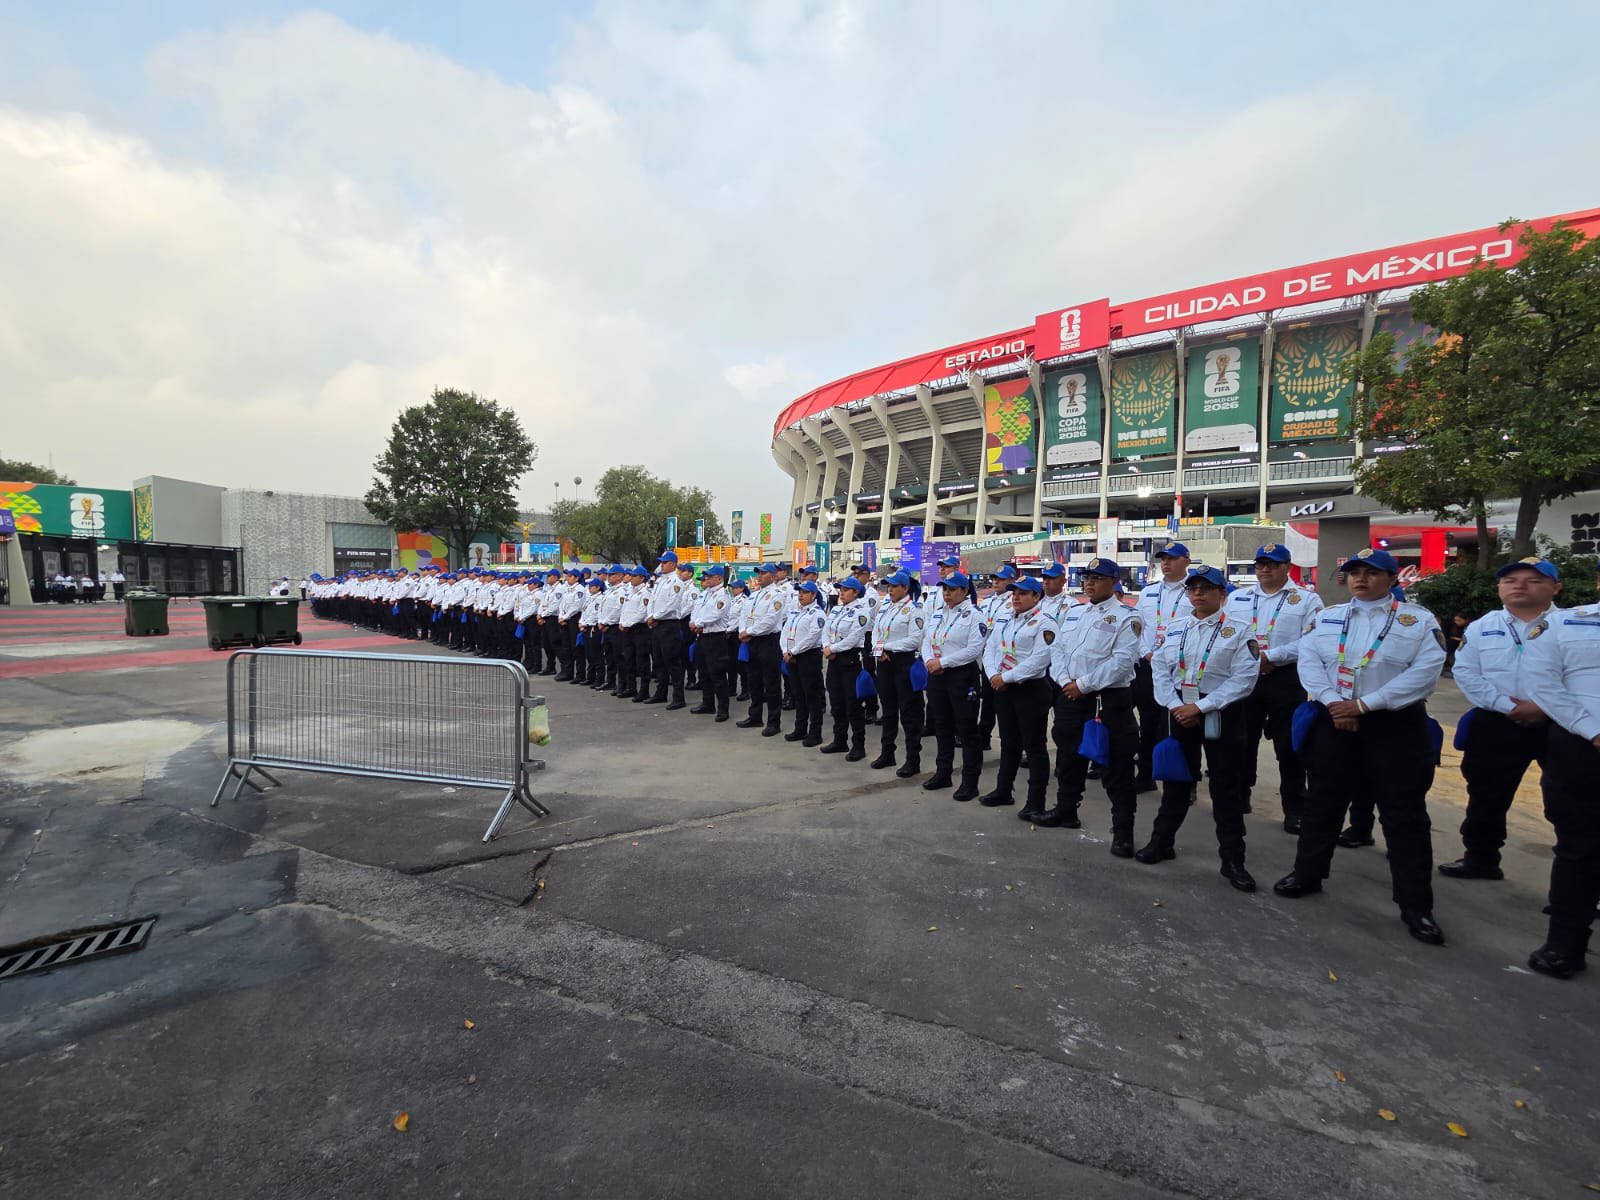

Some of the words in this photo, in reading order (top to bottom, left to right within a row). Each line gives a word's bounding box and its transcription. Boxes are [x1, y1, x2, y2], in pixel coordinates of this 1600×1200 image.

[1144, 286, 1267, 324] CIUDAD
[1283, 272, 1332, 298] DE
[1346, 239, 1513, 286] MÉXICO
[945, 339, 1026, 369] ESTADIO
[1203, 401, 1240, 412] 2026
[1058, 416, 1087, 428] COPA
[1282, 421, 1323, 431] CIUDAD
[1058, 425, 1088, 433] MUNDIAL
[1058, 430, 1087, 440] 2026
[995, 538, 1010, 546] FIFA
[1010, 534, 1035, 543] 2026
